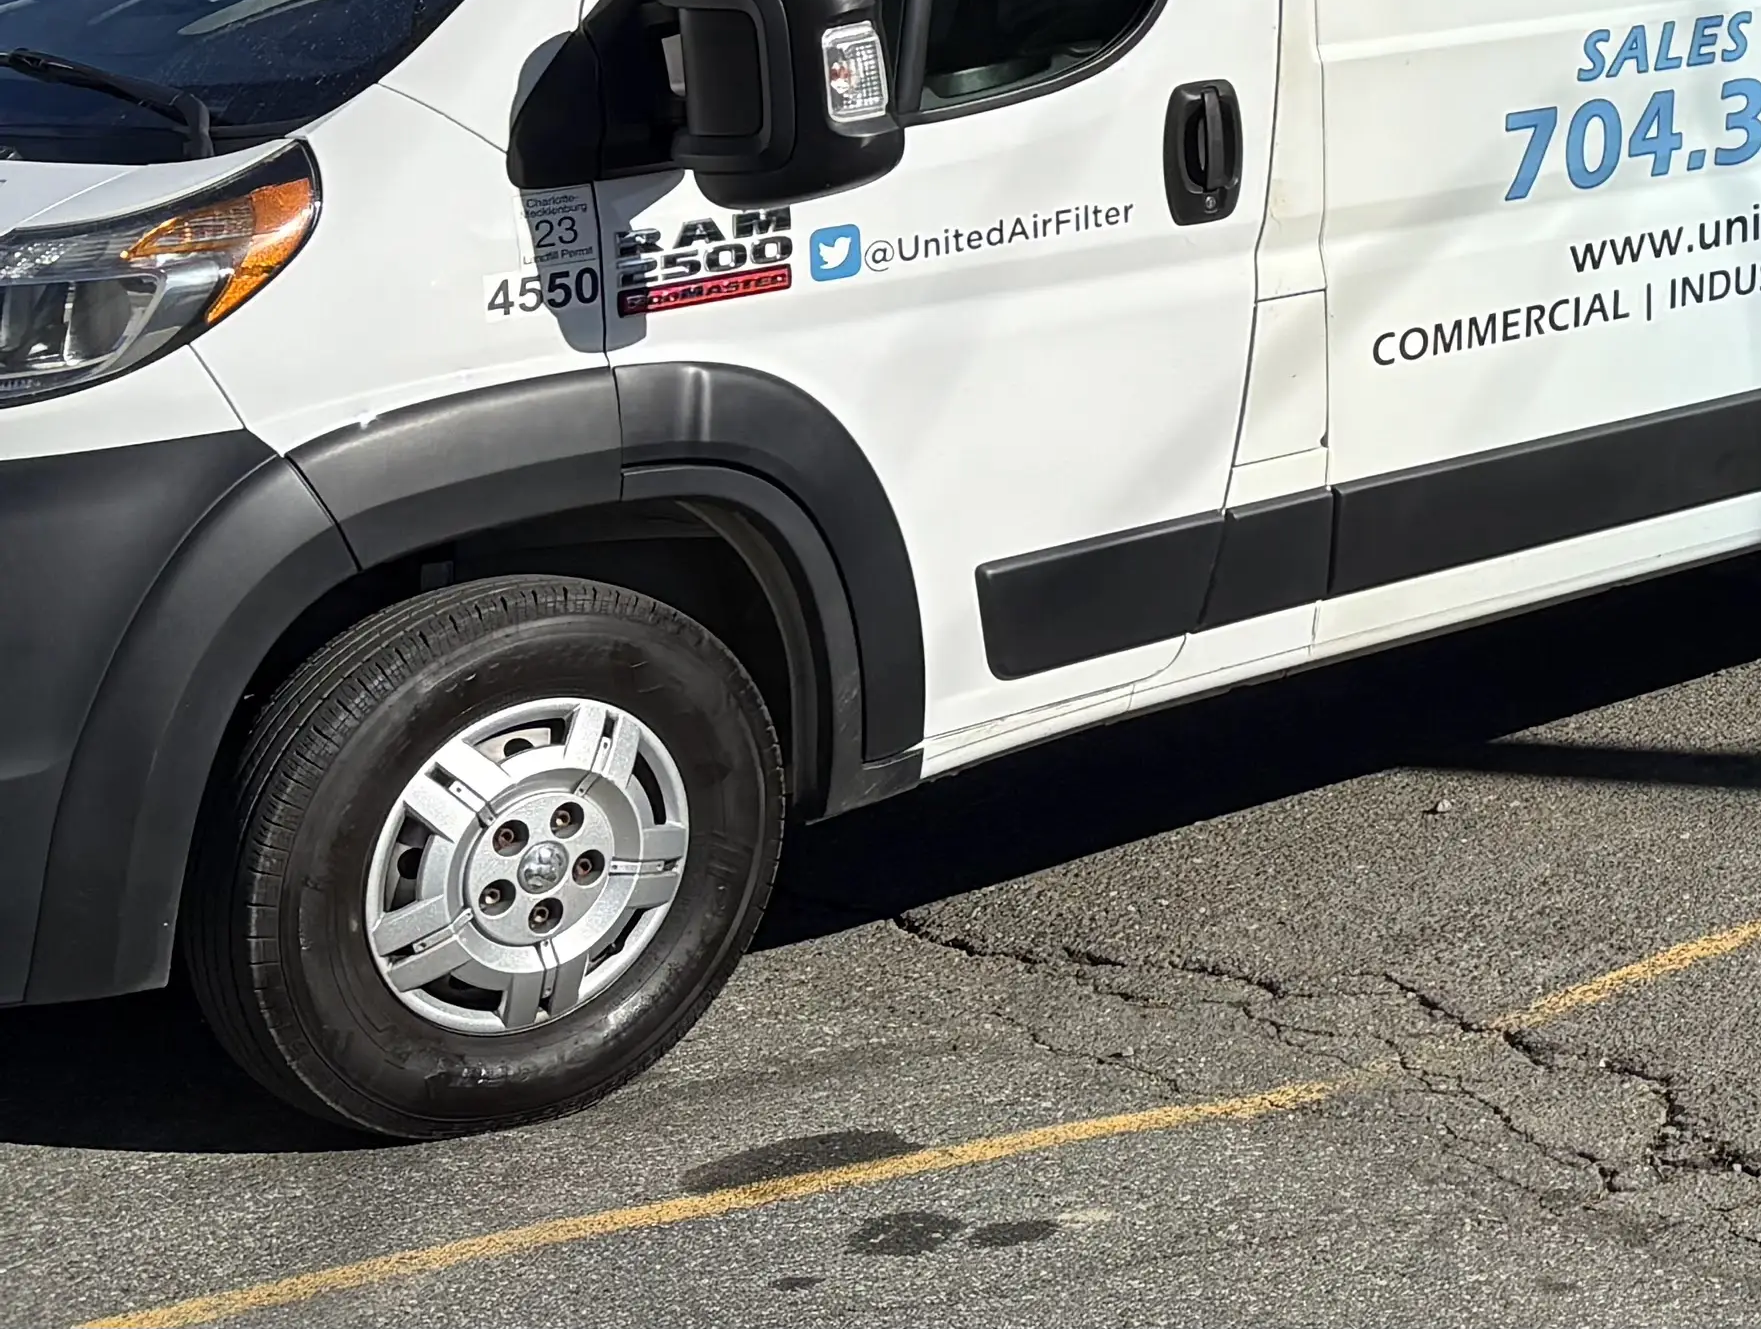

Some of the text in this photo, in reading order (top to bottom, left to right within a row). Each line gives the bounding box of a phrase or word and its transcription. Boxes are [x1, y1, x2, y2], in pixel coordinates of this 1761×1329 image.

[1577, 9, 1753, 82] SALES
[534, 216, 578, 248] 23
[615, 206, 792, 259] RAM
[864, 203, 1134, 273] @UnitedAirFilter
[616, 236, 793, 288] 2500
[487, 267, 599, 316] 4550
[1371, 289, 1631, 367] COMMERCIAL
